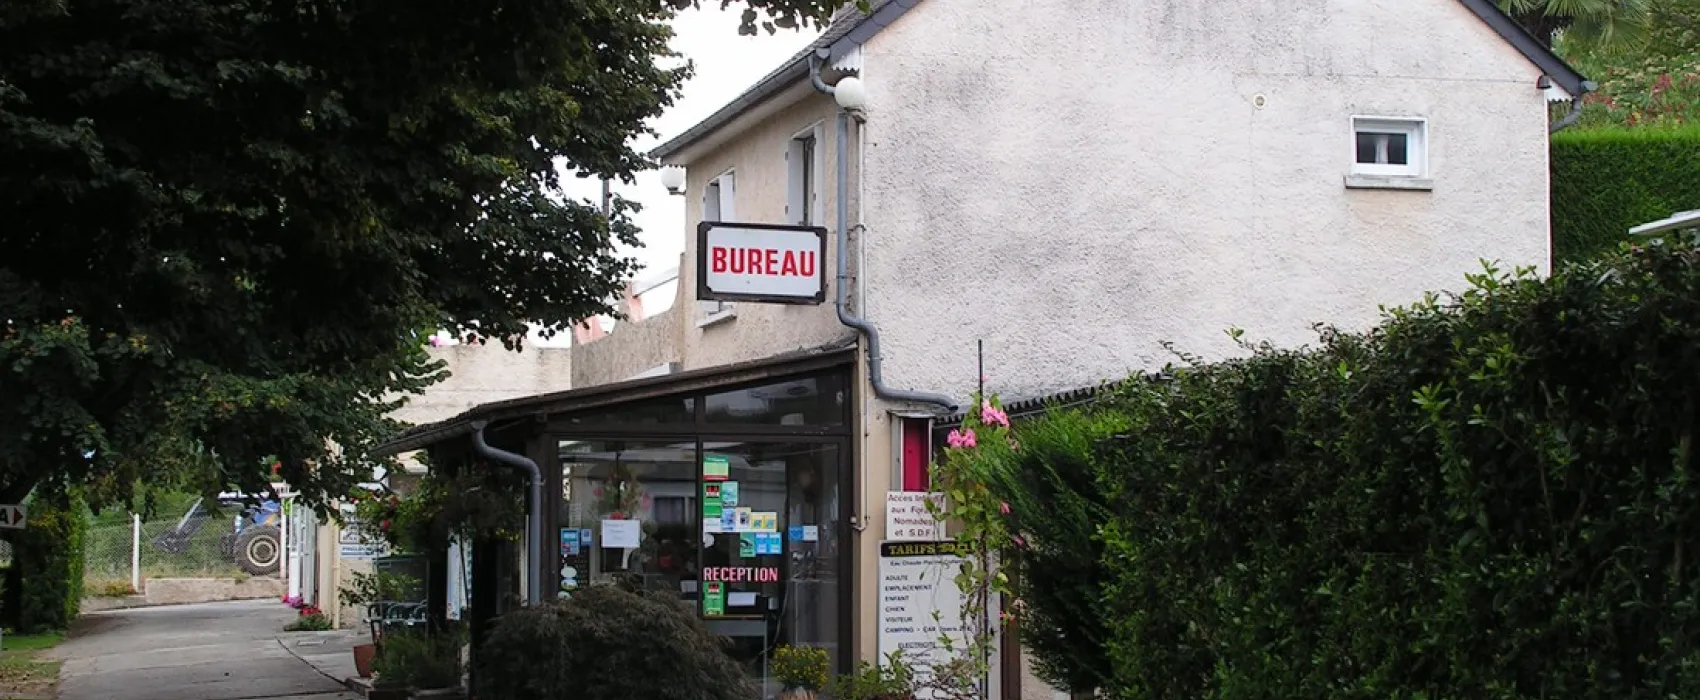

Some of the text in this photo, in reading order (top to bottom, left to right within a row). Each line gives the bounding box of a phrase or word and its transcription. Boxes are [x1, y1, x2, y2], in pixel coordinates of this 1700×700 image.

[712, 246, 815, 277] BUREAU
[894, 517, 933, 525] Nomades
[894, 529, 904, 537] et
[889, 544, 935, 555] TARIFS
[703, 567, 778, 582] RECEPTION
[885, 584, 932, 592] EMPLACEMENT
